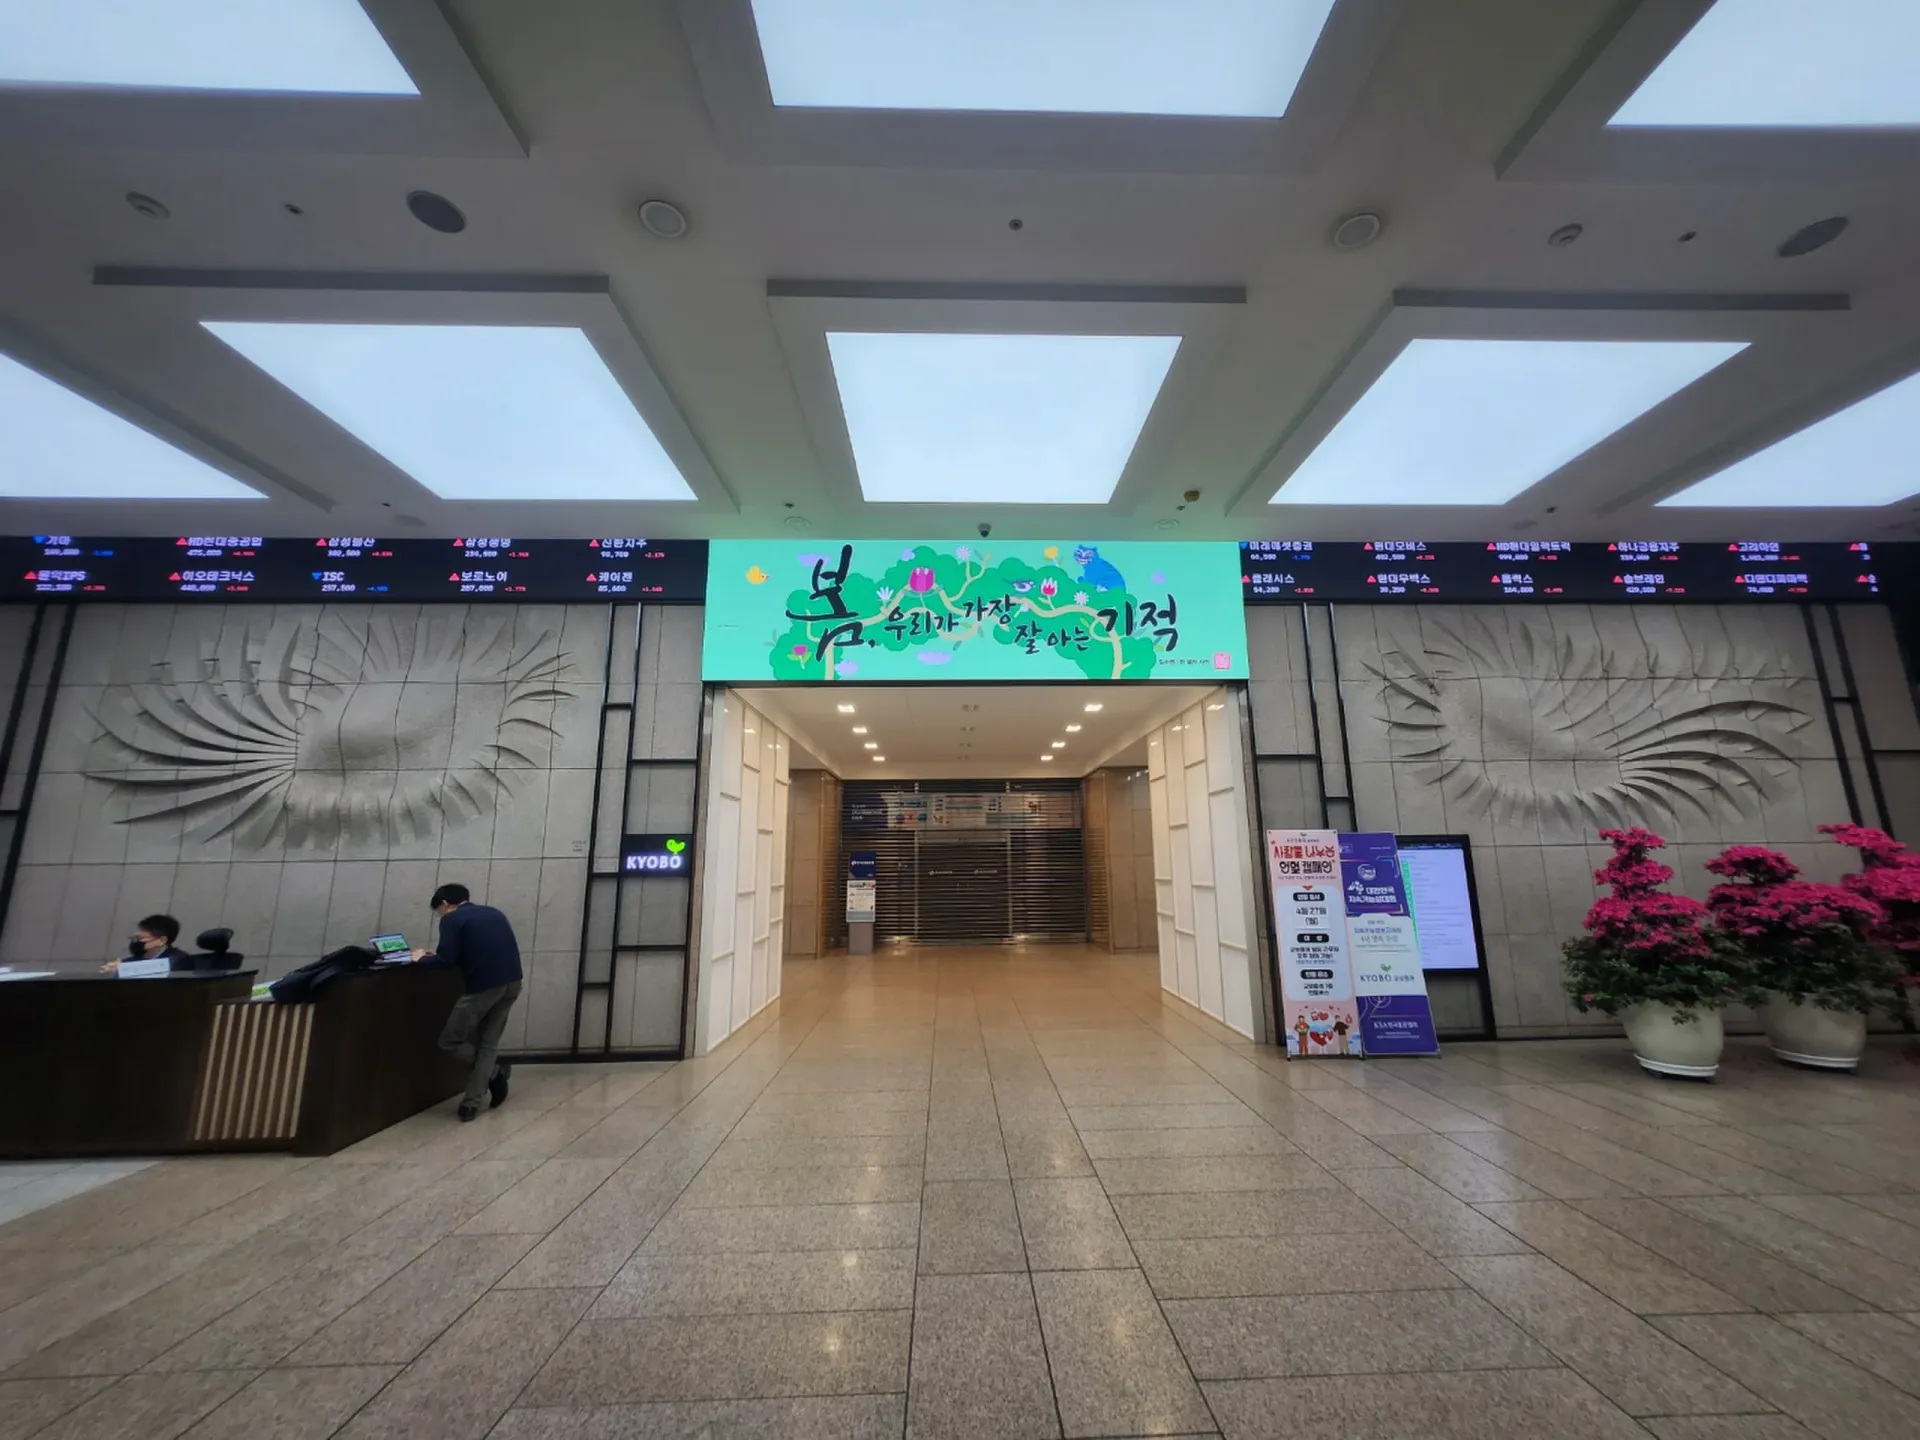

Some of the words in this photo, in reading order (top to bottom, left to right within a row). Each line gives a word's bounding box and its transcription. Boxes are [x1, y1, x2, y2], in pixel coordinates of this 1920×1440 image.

[321, 572, 345, 582] ISC
[460, 572, 508, 582] 보로노이
[785, 544, 876, 662] 봄,
[884, 606, 959, 640] 우리가
[962, 594, 1017, 625] 가장
[1014, 620, 1043, 655] 잘
[1046, 626, 1090, 652] 아는
[1097, 593, 1180, 652] 기적
[626, 855, 682, 869] KYOBO
[1302, 860, 1333, 874] 캠페인
[1360, 974, 1391, 982] KYOBO
